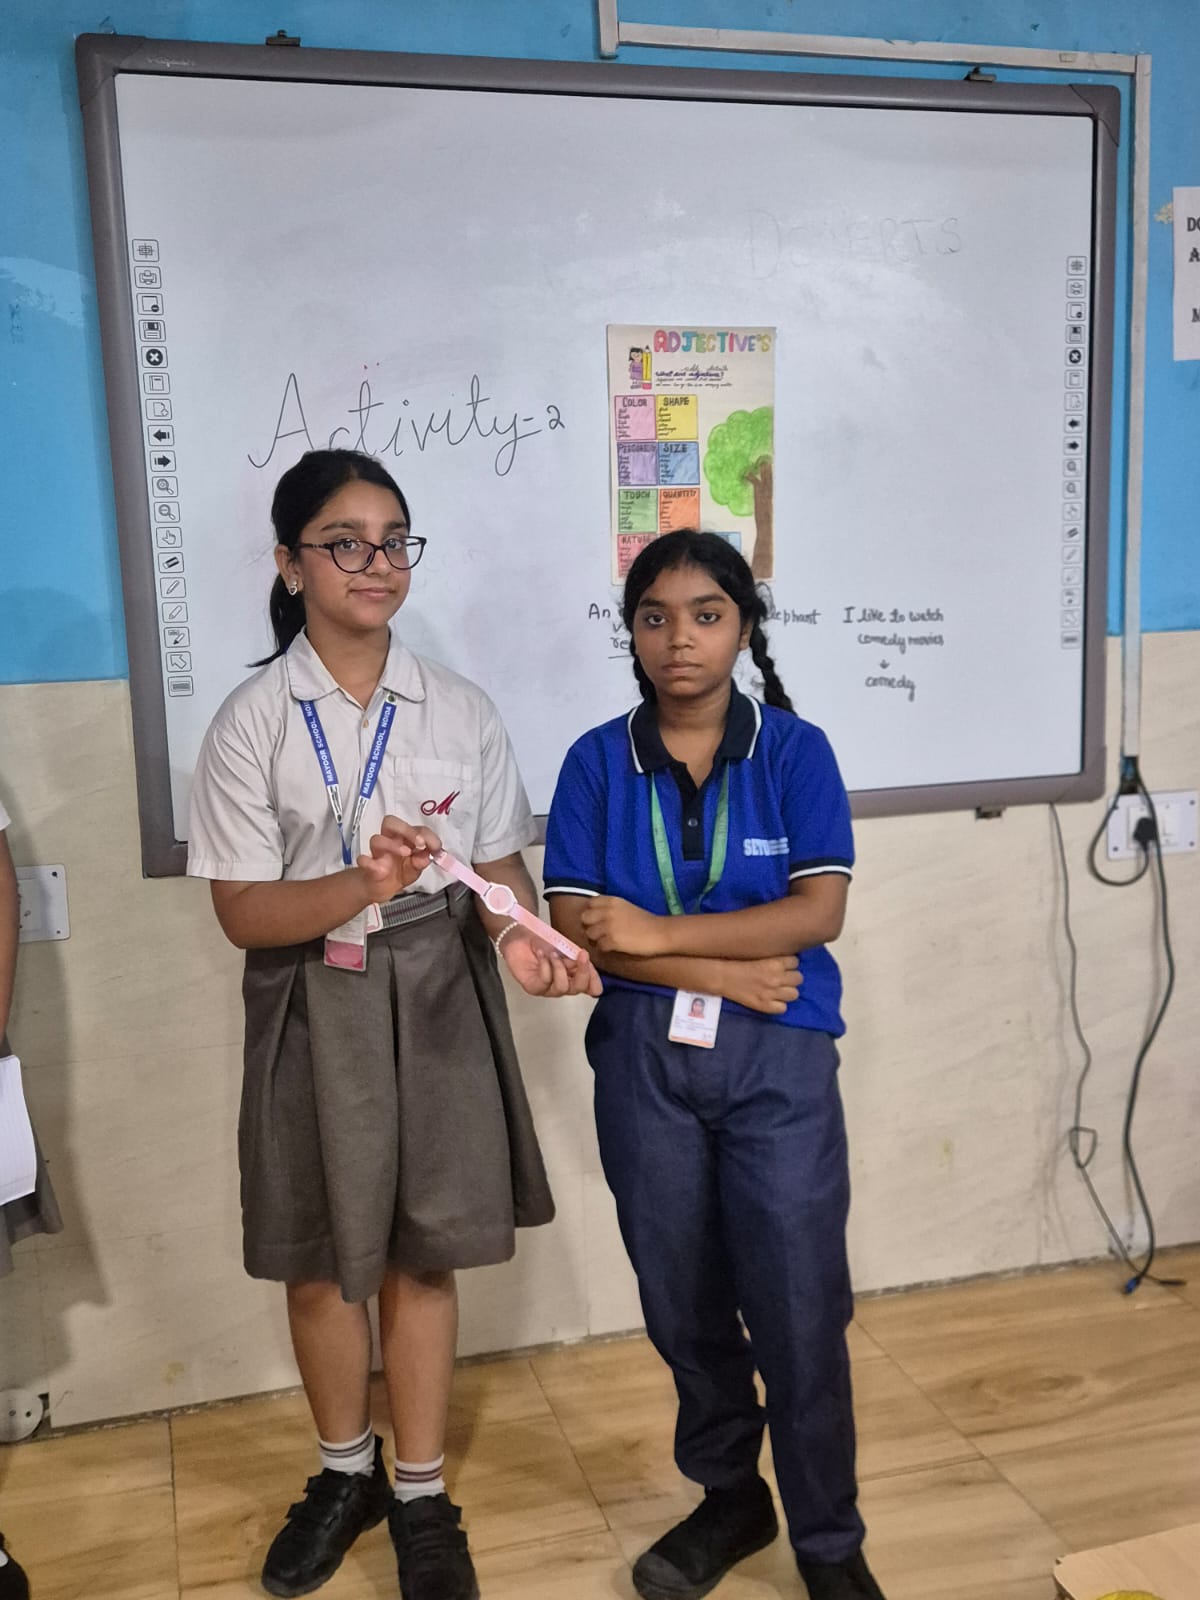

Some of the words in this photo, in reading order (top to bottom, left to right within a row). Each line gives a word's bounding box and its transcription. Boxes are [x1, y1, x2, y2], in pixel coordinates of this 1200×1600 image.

[653, 329, 772, 353] ADJECTIVE'S
[622, 397, 648, 407] COLOR
[663, 397, 690, 407] SHAPE
[663, 442, 688, 453] SIZE
[588, 602, 611, 620] An
[842, 605, 856, 623] I
[857, 607, 887, 623] like
[889, 608, 906, 623] to
[909, 607, 944, 622] watch
[857, 632, 906, 655] comedy
[907, 632, 945, 647] movies
[864, 674, 916, 702] comedy
[362, 761, 377, 795] MAYOOR
[381, 705, 393, 728] NOIDA
[319, 748, 334, 782] MAYOOR
